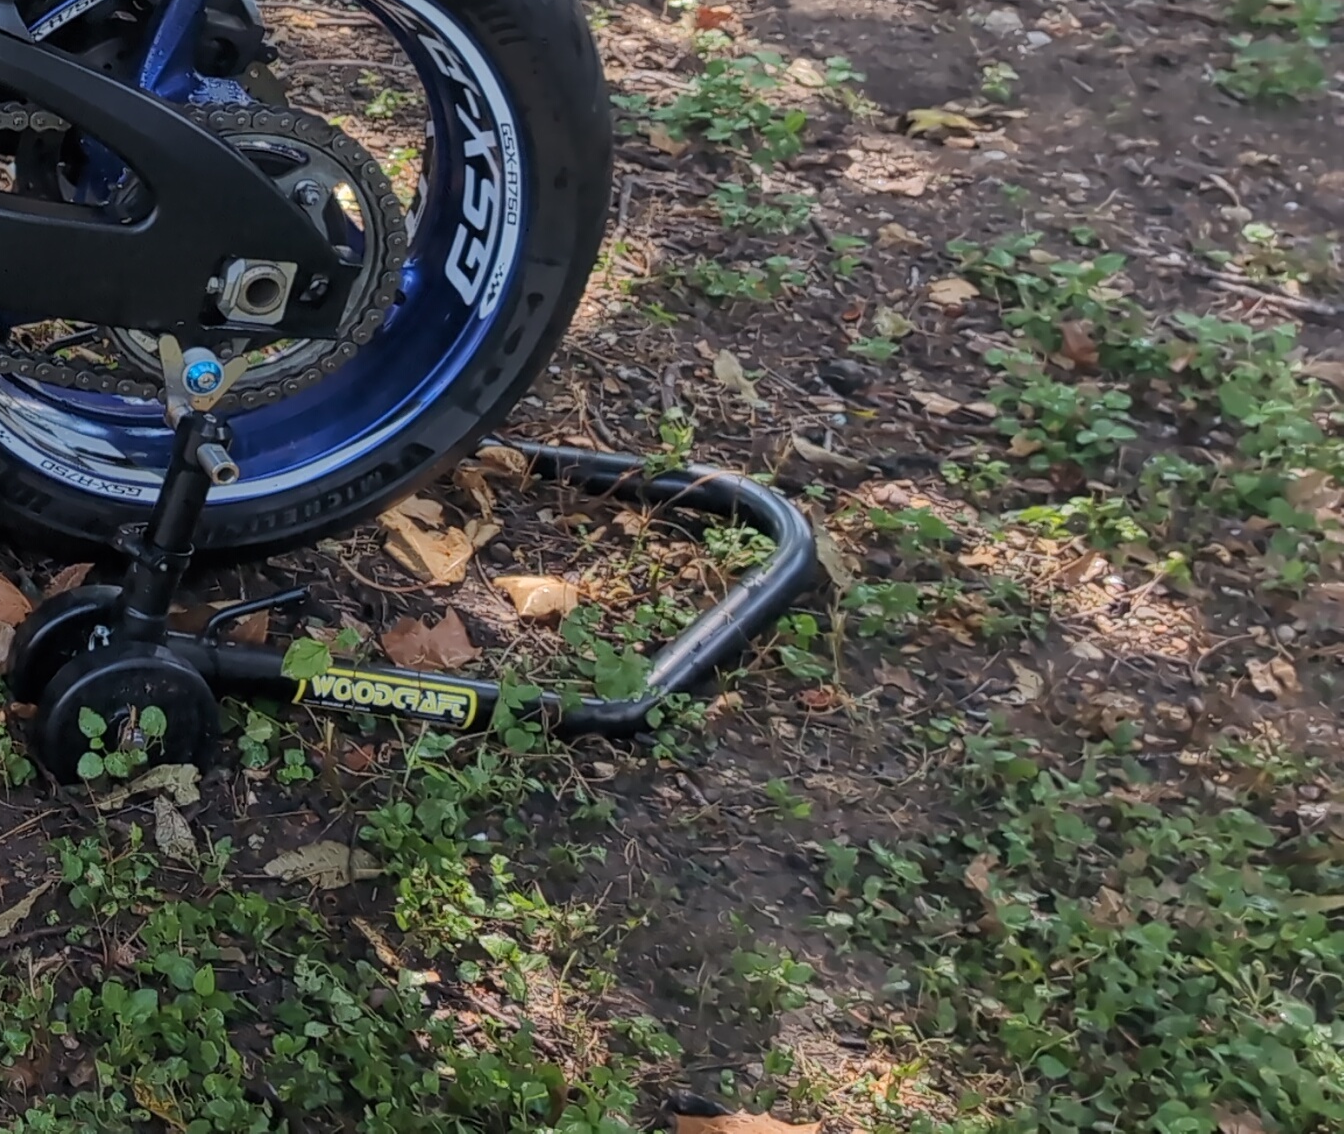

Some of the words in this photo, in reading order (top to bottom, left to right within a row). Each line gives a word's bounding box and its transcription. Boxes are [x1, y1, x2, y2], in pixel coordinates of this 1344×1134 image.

[500, 122, 519, 226] GSX-R750
[40, 460, 143, 498] GSX-R750
[311, 675, 469, 718] WOODCRAFT
